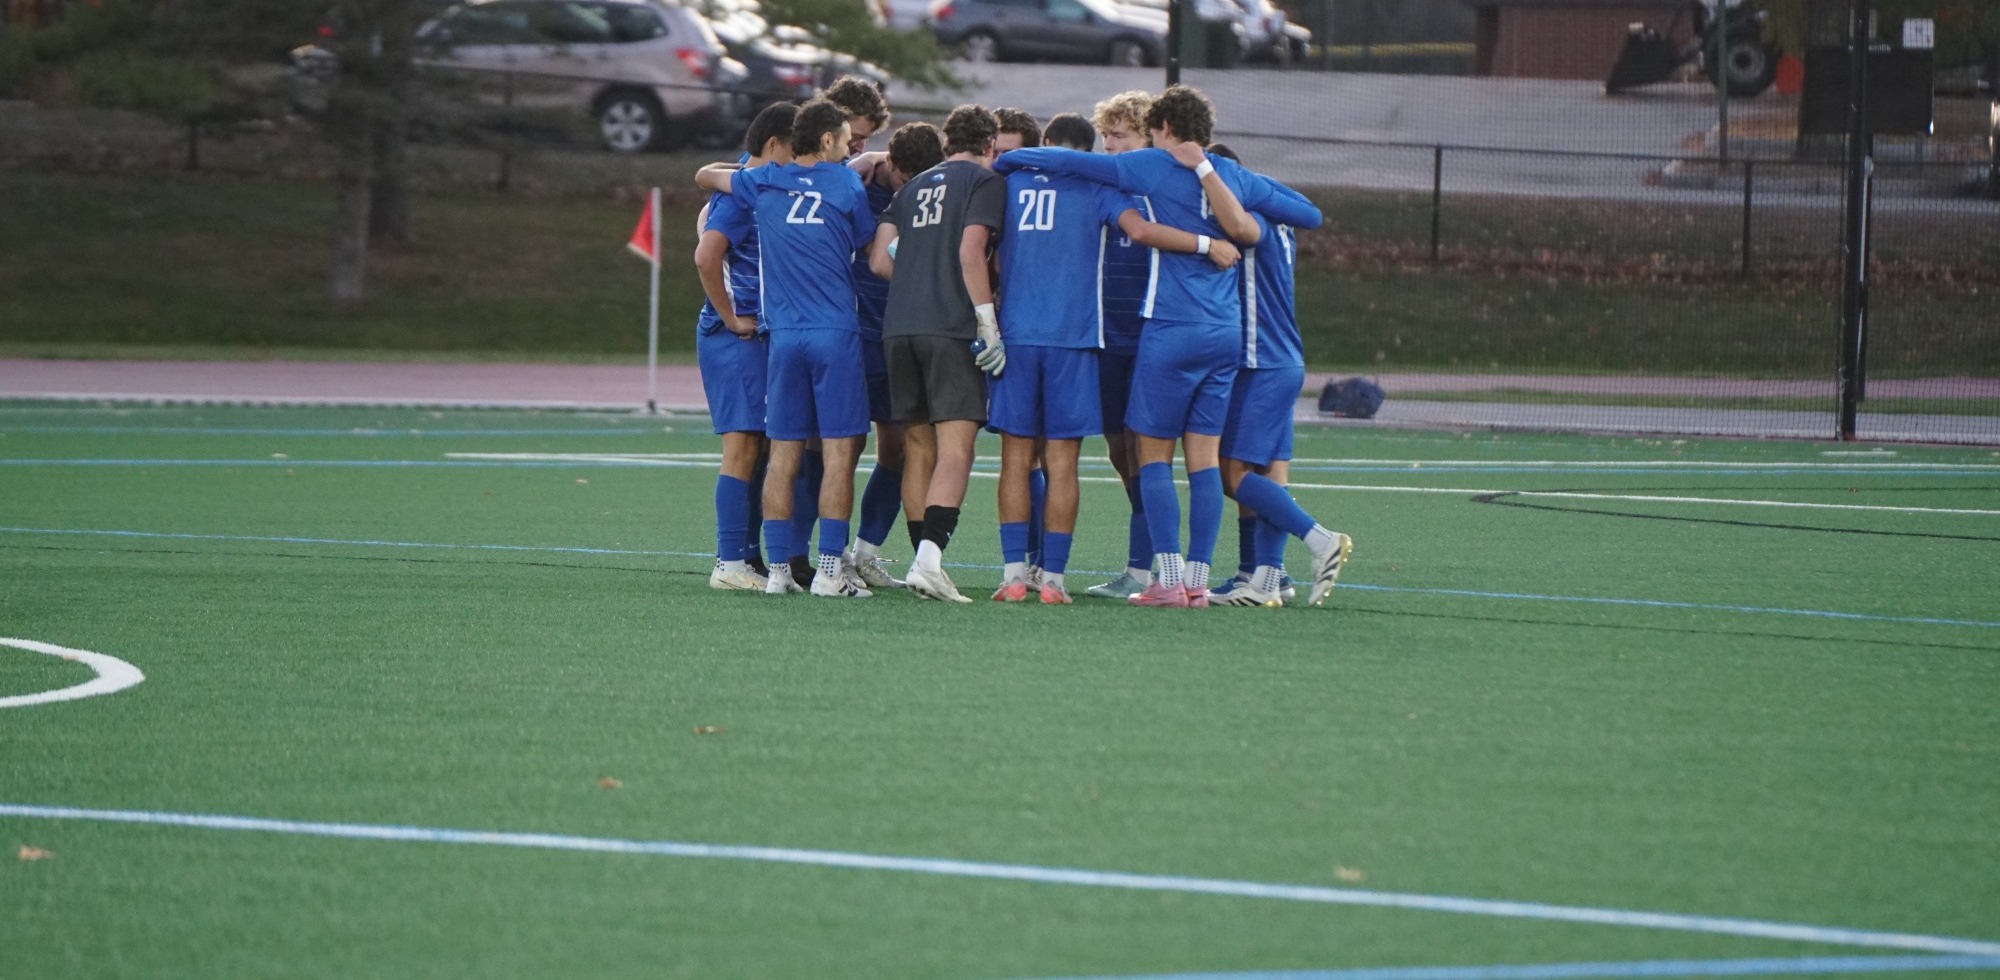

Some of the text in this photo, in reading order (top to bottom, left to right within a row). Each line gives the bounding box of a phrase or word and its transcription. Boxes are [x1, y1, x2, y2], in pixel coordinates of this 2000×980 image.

[786, 190, 824, 224] 22
[912, 184, 947, 228] 33
[1018, 189, 1057, 231] 20
